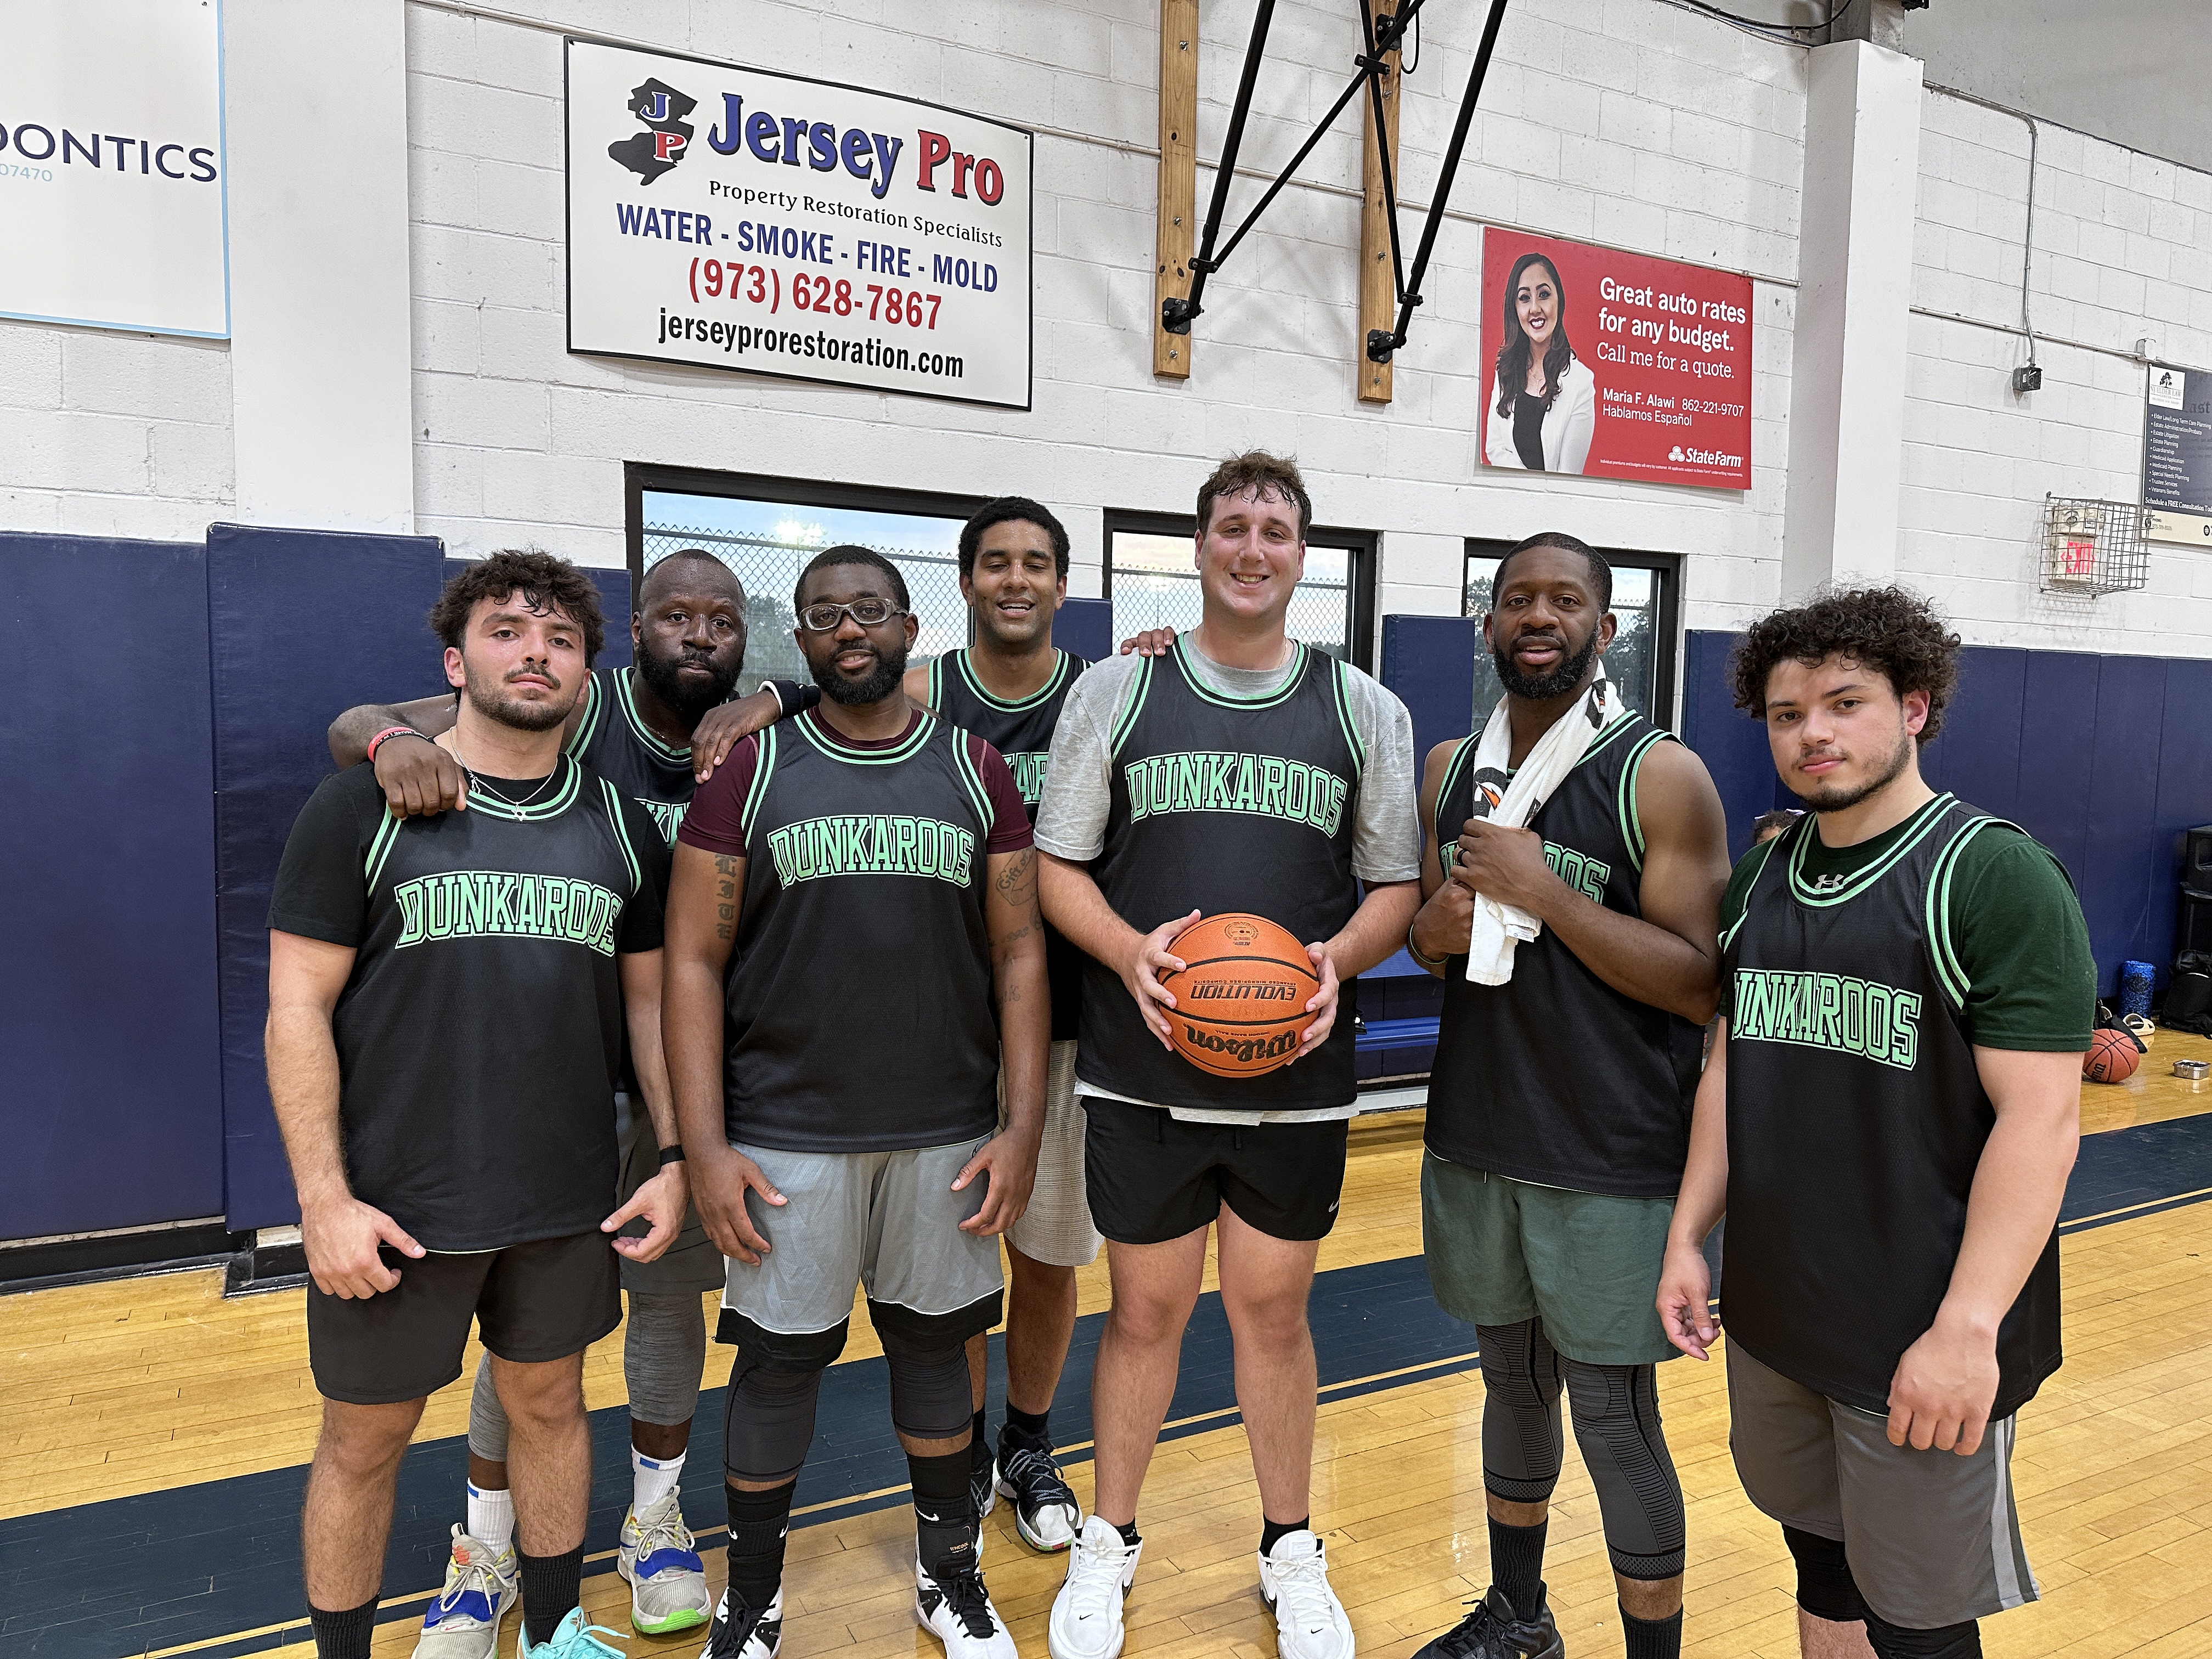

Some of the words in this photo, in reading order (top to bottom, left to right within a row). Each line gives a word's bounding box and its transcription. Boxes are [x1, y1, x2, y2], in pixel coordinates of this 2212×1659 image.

[639, 91, 672, 122] J
[0, 122, 217, 183] ONTICS
[653, 130, 687, 163] P
[708, 92, 904, 199] Jersey
[917, 129, 1005, 207] Pro
[0, 163, 53, 182] 07470
[709, 180, 797, 211] Property
[803, 196, 909, 229] Restoration
[913, 216, 1003, 248] Specialists
[616, 203, 713, 246] WATER
[737, 221, 834, 265] SMOKE
[857, 240, 912, 279] FIRE
[933, 254, 998, 294] MOLD
[689, 257, 781, 314] (973)
[792, 273, 942, 331] 628-7867
[1599, 276, 1654, 308] Great
[1658, 291, 1697, 316] auto
[1702, 301, 1746, 325] rates
[658, 308, 964, 379] jerseyprorestoration.com
[1598, 307, 1627, 332] for
[1631, 318, 1664, 345] any
[1668, 319, 1735, 353] budget.
[1596, 342, 1626, 364] Call
[1629, 349, 1654, 367] me
[1656, 351, 1677, 370] for
[1679, 358, 1689, 373] a
[1692, 359, 1735, 379] quote.
[1602, 387, 1633, 404] Maria
[1634, 392, 1645, 405] F.
[1646, 394, 1675, 409] Alawi
[1681, 398, 1745, 417] 862-221-9707
[1602, 403, 1652, 422] Hablamos
[1655, 410, 1692, 427] Español
[2066, 541, 2092, 574] EXIT
[1125, 751, 1347, 839] DUNKAROOS
[768, 814, 974, 890] DUNKAROOS
[394, 871, 622, 957] DUNKAROOS
[1190, 984, 1296, 1001] EVOLUTION
[1184, 1024, 1297, 1062] Wilson
